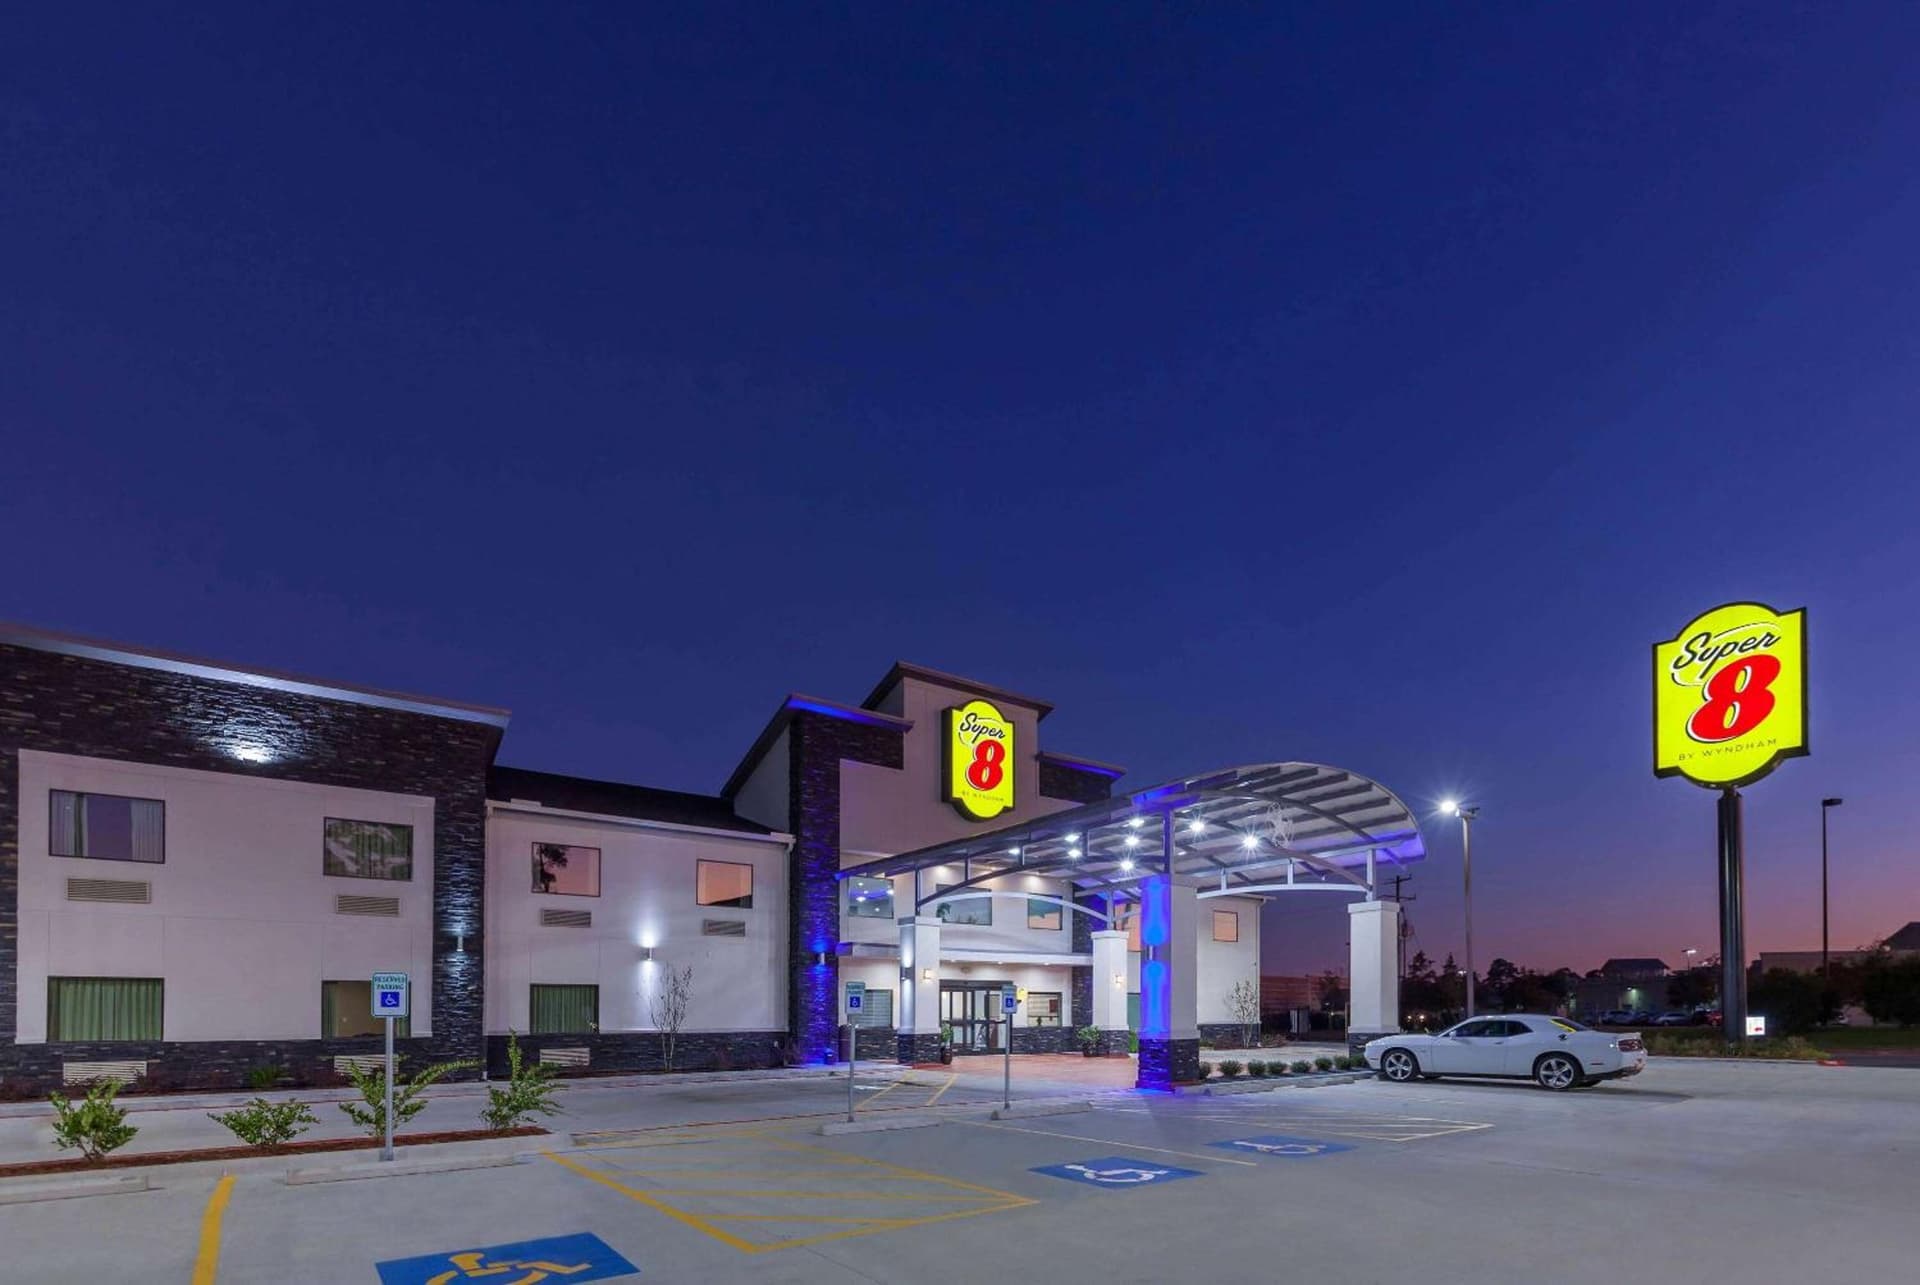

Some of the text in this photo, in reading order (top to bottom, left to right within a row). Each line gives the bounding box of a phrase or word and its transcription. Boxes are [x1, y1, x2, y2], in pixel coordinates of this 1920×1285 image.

[1672, 631, 1781, 680] Super
[1685, 654, 1781, 744] 8
[960, 712, 1006, 744] Super
[1678, 738, 1778, 761] BY WYNDHAM
[965, 739, 1006, 791] 8
